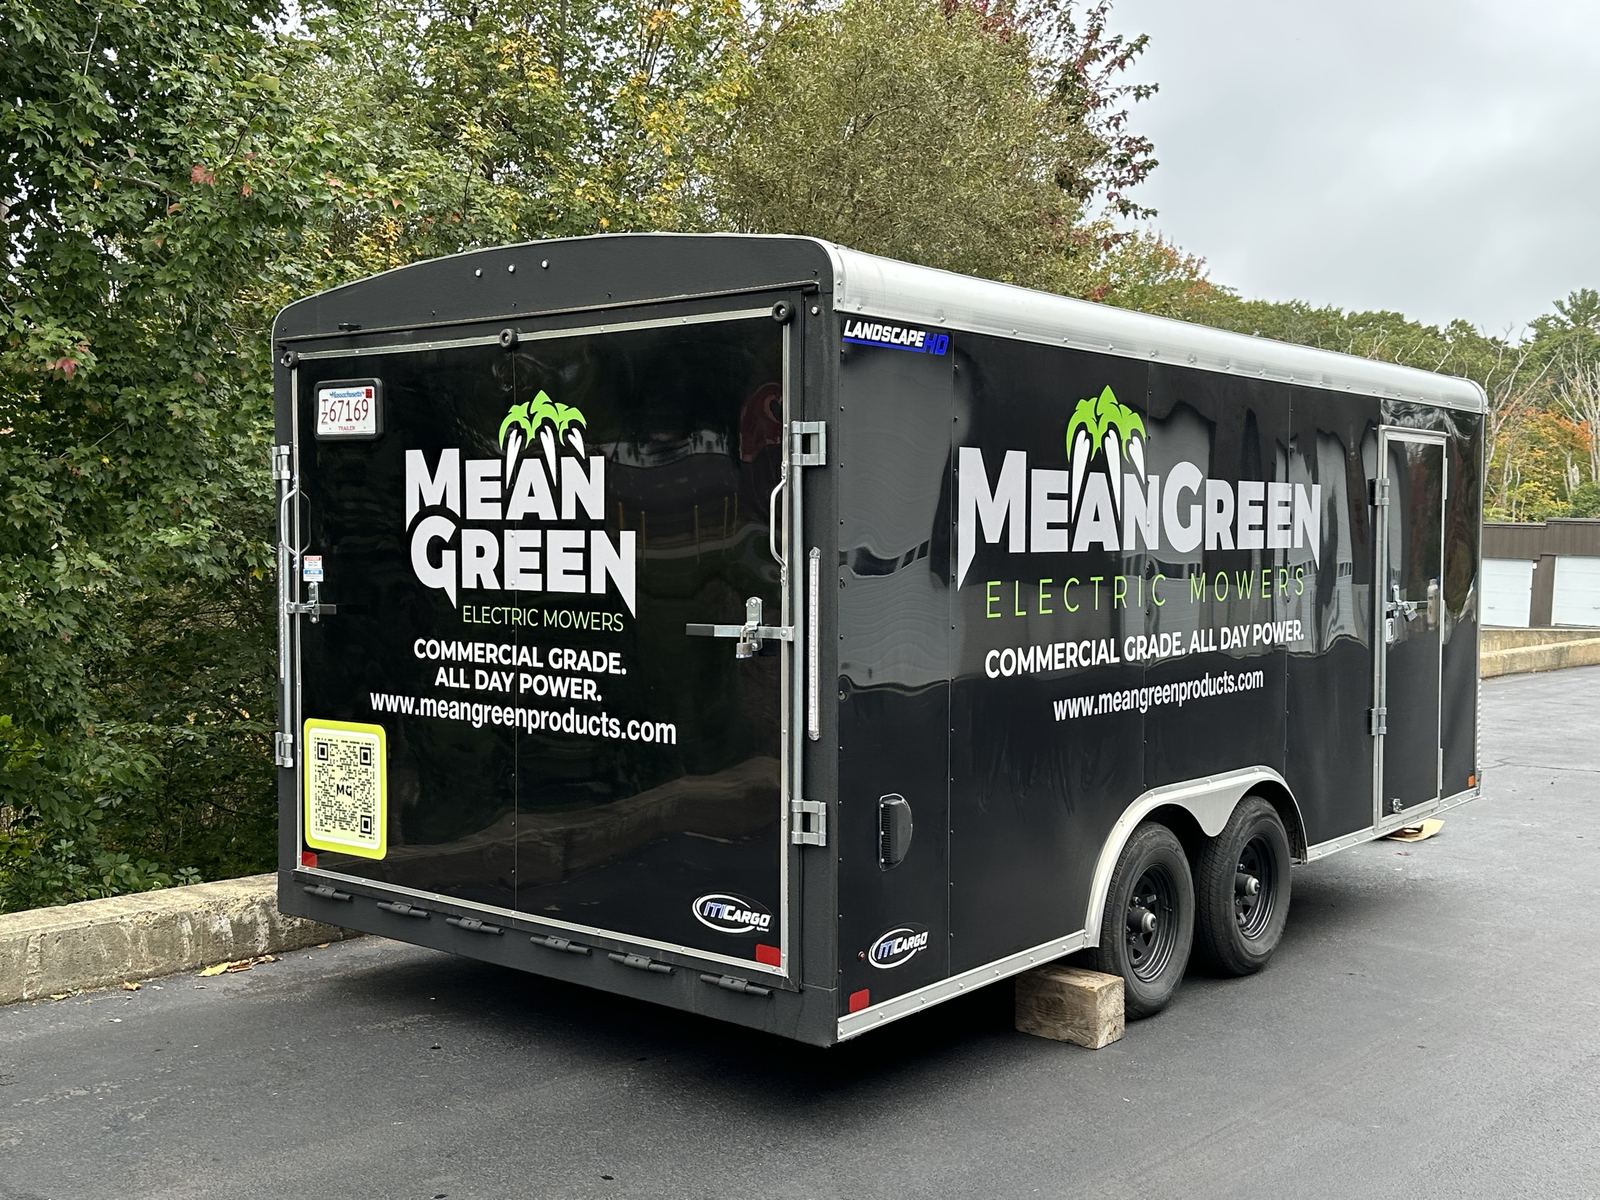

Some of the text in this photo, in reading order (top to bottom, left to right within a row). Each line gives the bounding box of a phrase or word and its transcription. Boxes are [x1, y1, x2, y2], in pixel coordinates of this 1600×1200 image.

[329, 398, 369, 422] 67169
[405, 447, 605, 533] MEAN
[410, 515, 637, 619] GREEN
[985, 567, 1305, 619] ELECTRIC MOWERS
[462, 605, 625, 633] ELECTRIC MOWERS
[413, 638, 627, 676] COMMERCIAL GRADE.
[984, 619, 1305, 679] COMMERCIAL GRADE. ALL DAY POWER.
[434, 667, 603, 702] ALL DAY POWER.
[1053, 668, 1265, 722] www.meangreenproducts.com
[370, 692, 678, 745] www.meangreenproducts.com
[336, 783, 353, 798] MG
